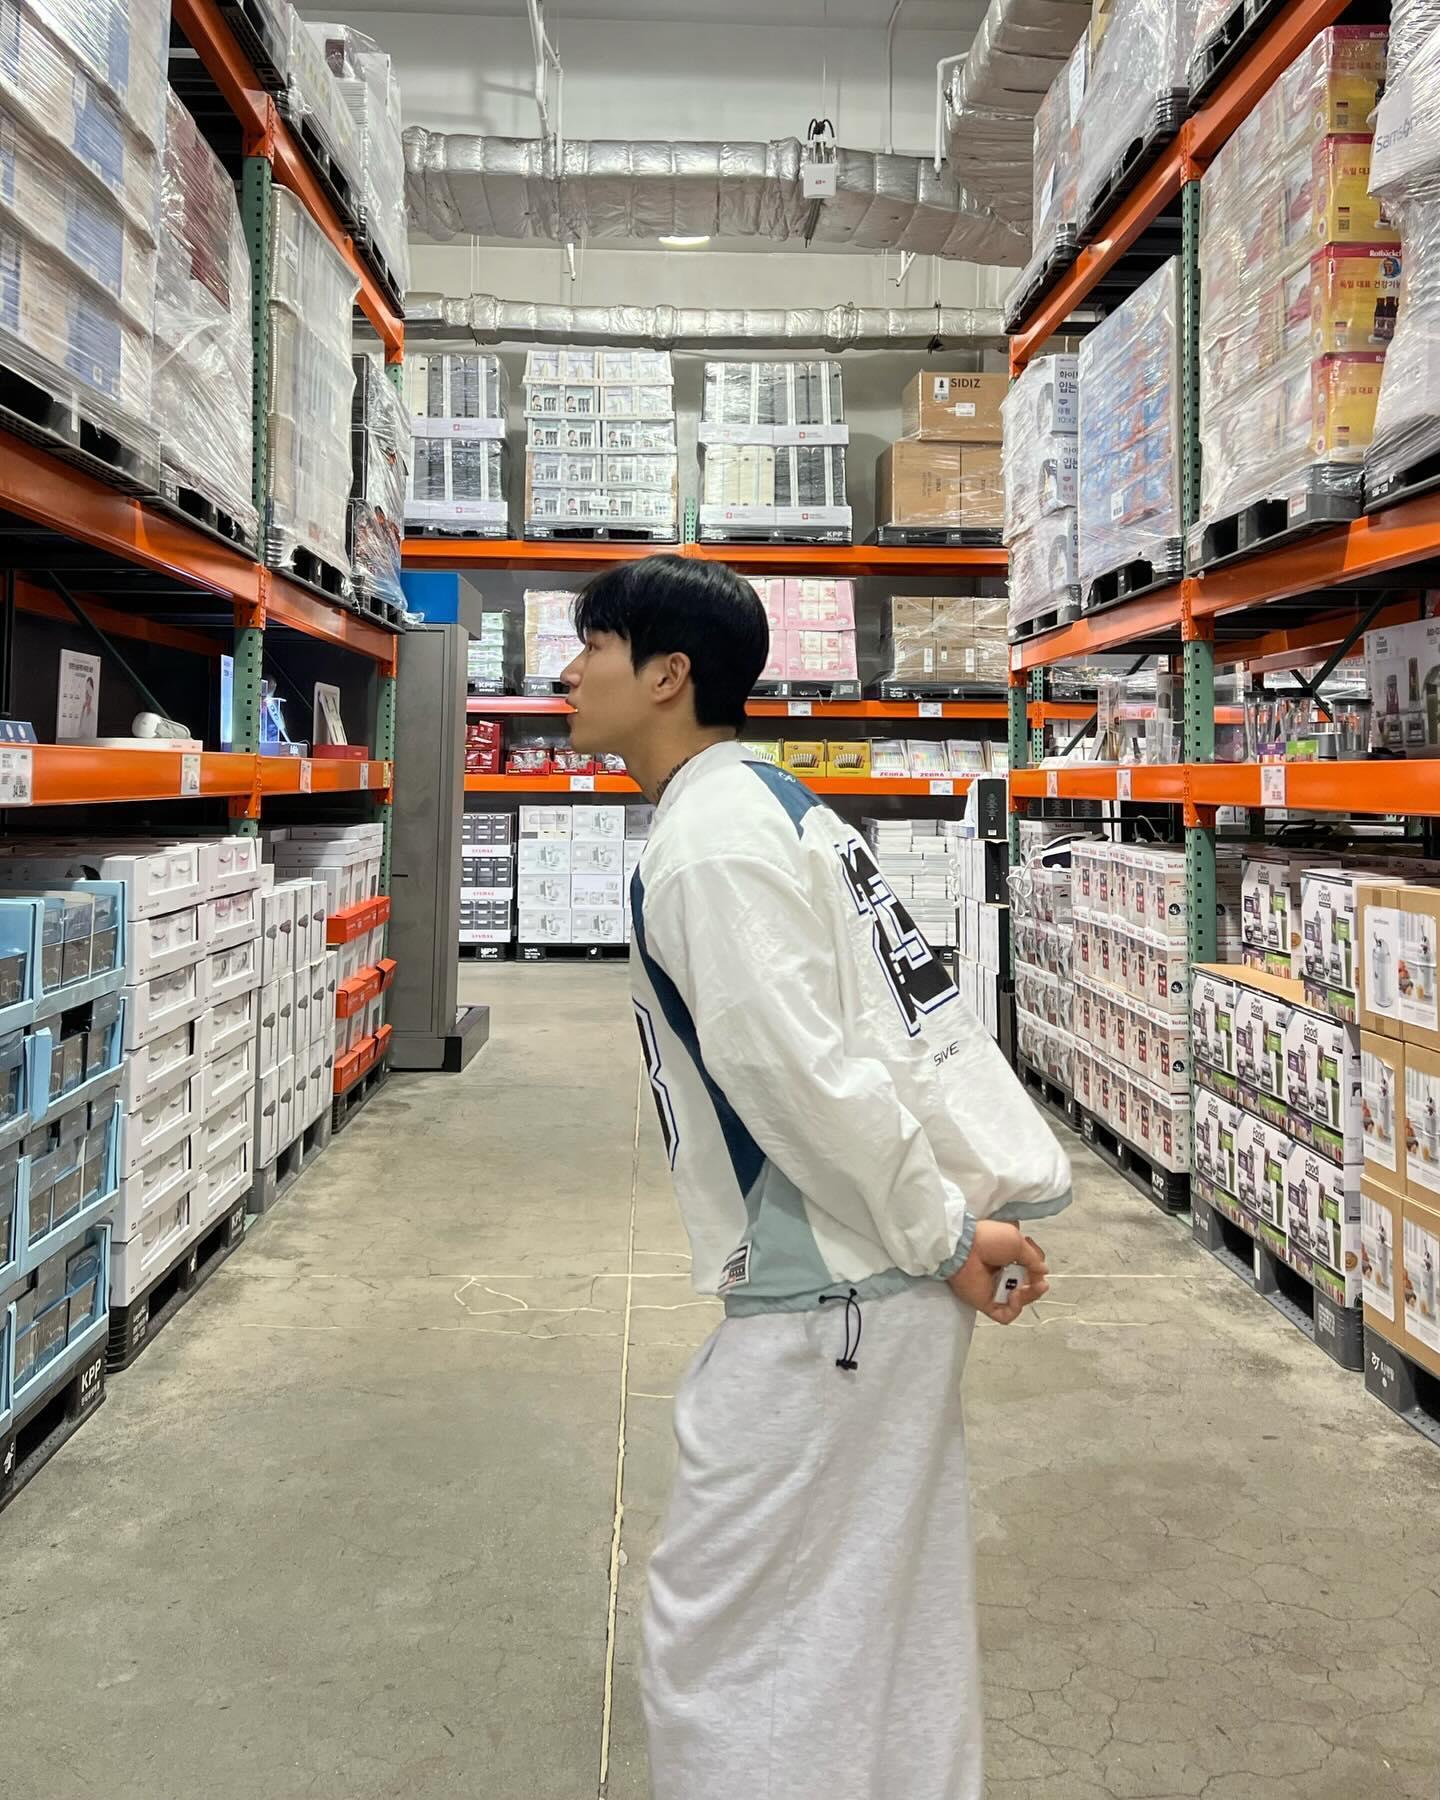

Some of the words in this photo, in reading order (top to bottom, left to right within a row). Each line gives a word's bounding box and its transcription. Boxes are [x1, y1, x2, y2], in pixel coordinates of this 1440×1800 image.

[950, 378, 981, 388] SIDIZ
[933, 1040, 960, 1067] SIVE
[81, 1358, 102, 1393] KPP
